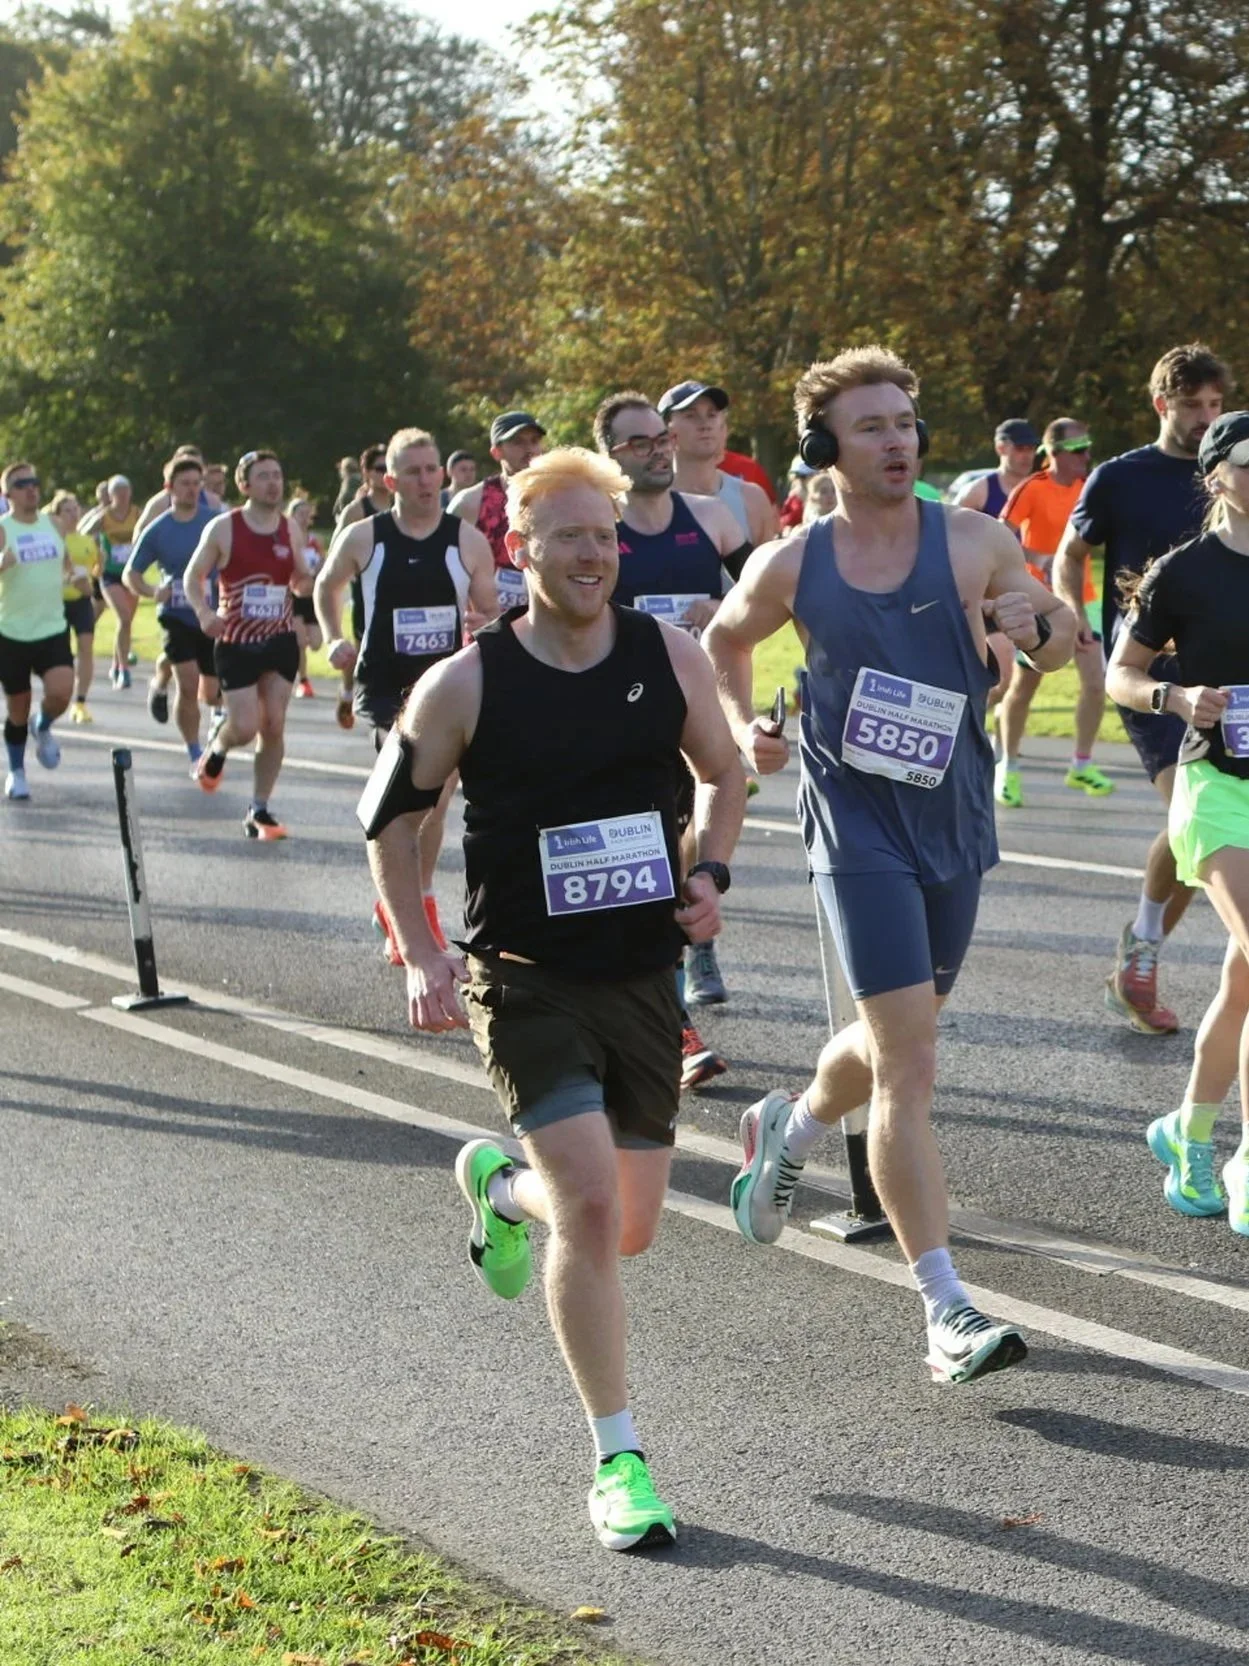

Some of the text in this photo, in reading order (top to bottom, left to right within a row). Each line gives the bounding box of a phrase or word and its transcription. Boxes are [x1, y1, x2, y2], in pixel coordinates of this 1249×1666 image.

[403, 633, 448, 651] 7463
[876, 684, 893, 695] Irish
[892, 688, 907, 700] Life
[918, 693, 956, 712] DUBLIN
[856, 700, 887, 715] DUBLIN
[887, 709, 909, 721] HALF
[910, 717, 953, 733] MARATHON
[855, 717, 939, 761] 5850
[905, 770, 937, 787] 5850
[608, 823, 652, 839] DUBLIN
[564, 838, 582, 847] Irish
[581, 834, 597, 845] Life
[550, 848, 661, 871] DUBLIN HALF MARATHON
[563, 865, 657, 904] 8794
